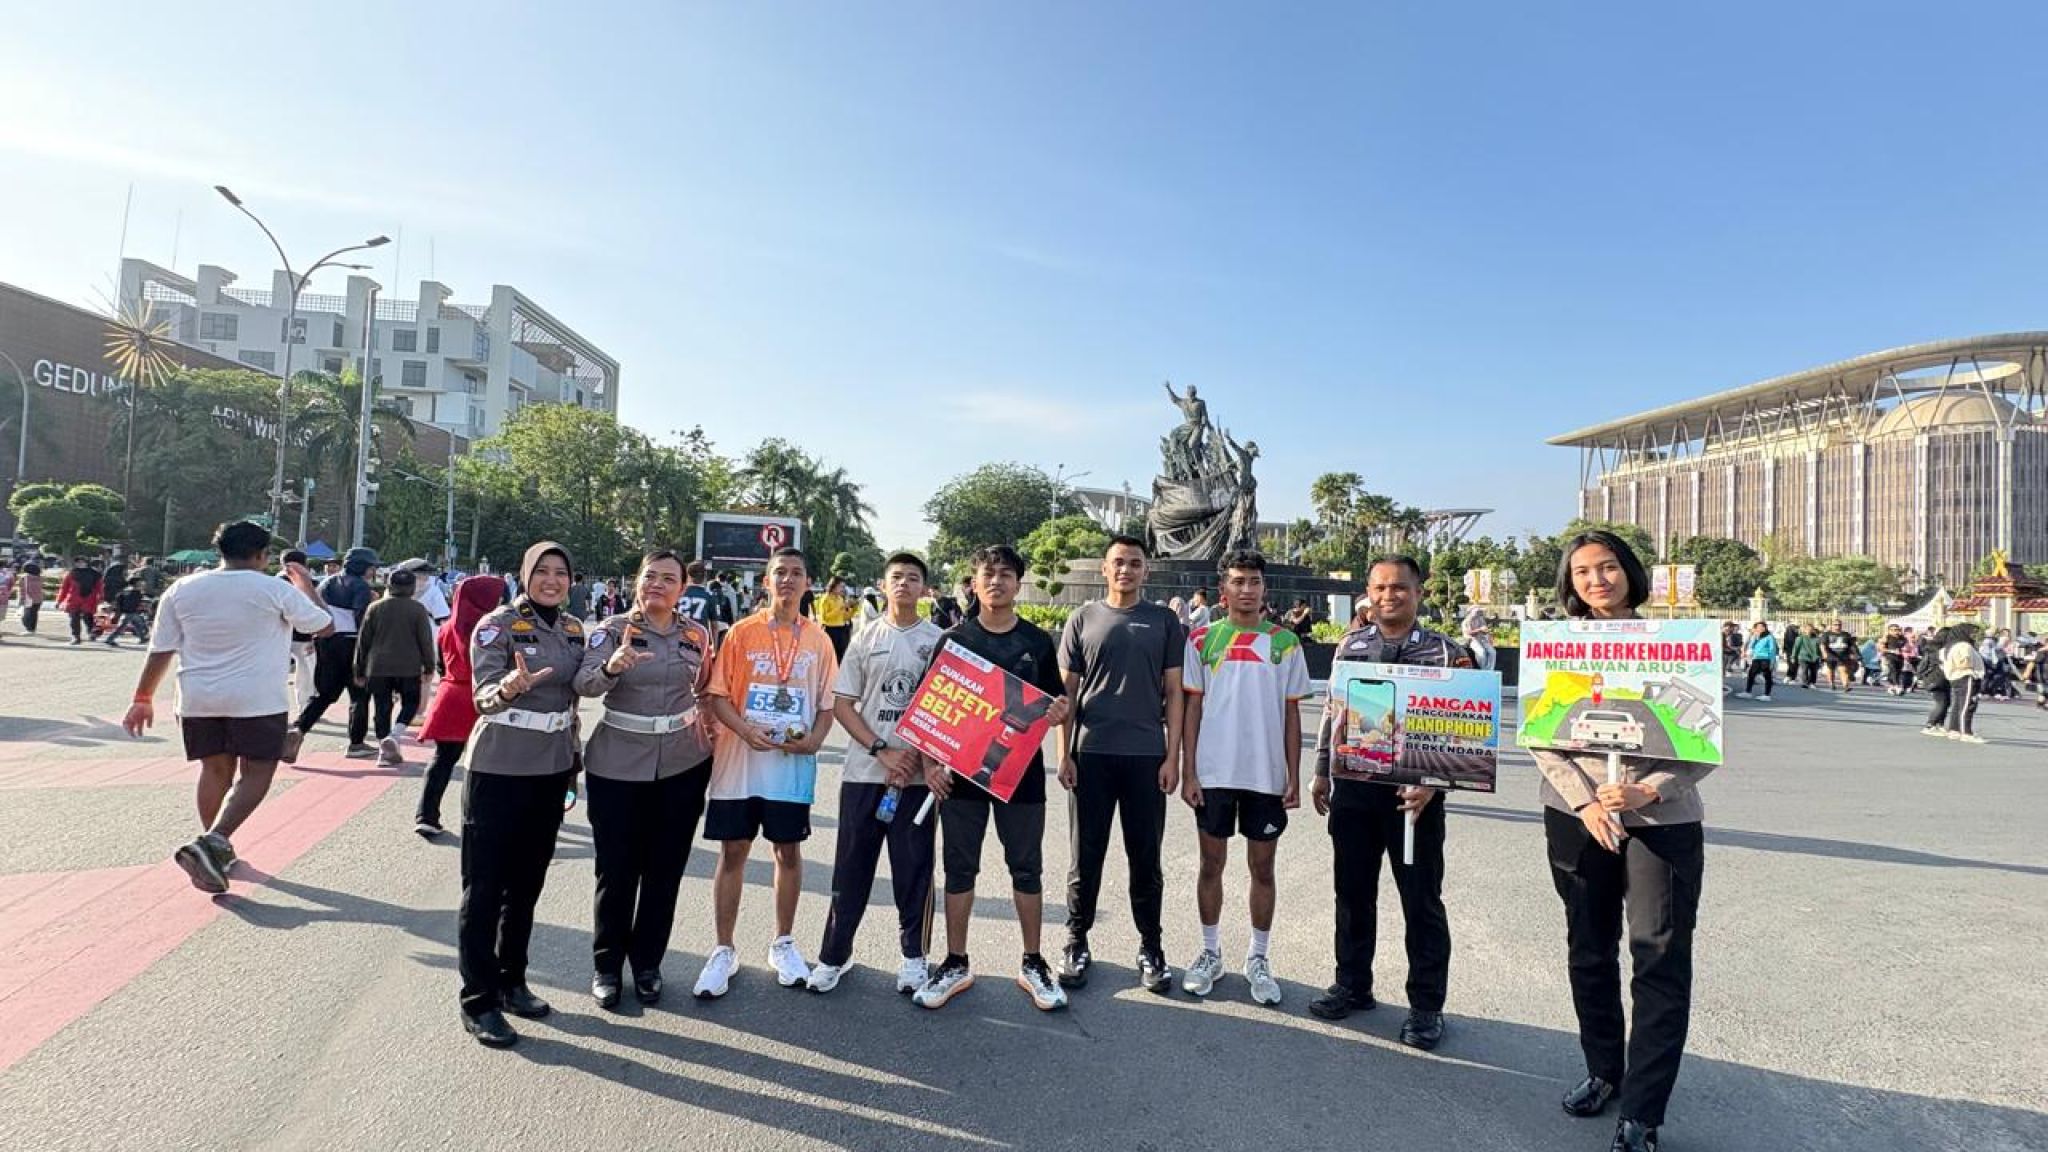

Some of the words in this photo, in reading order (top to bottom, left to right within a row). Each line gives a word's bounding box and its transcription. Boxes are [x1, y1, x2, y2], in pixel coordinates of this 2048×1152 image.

[678, 597, 706, 618] 27
[1526, 642, 1586, 660] JANGAN
[1592, 642, 1713, 662] BERKENDARA
[1545, 661, 1630, 673] MELAWAN
[1636, 662, 1687, 674] ARUS
[940, 664, 985, 695] GUNAKAN
[929, 674, 1000, 721] SAFETY
[1407, 695, 1492, 713] JANGAN
[920, 691, 967, 727] BELT
[1406, 708, 1492, 721] MENGGUNAKAN
[1406, 716, 1493, 737] HANDPHONE
[1405, 732, 1438, 742] SAAT
[1405, 742, 1493, 756] BERKENDARA
